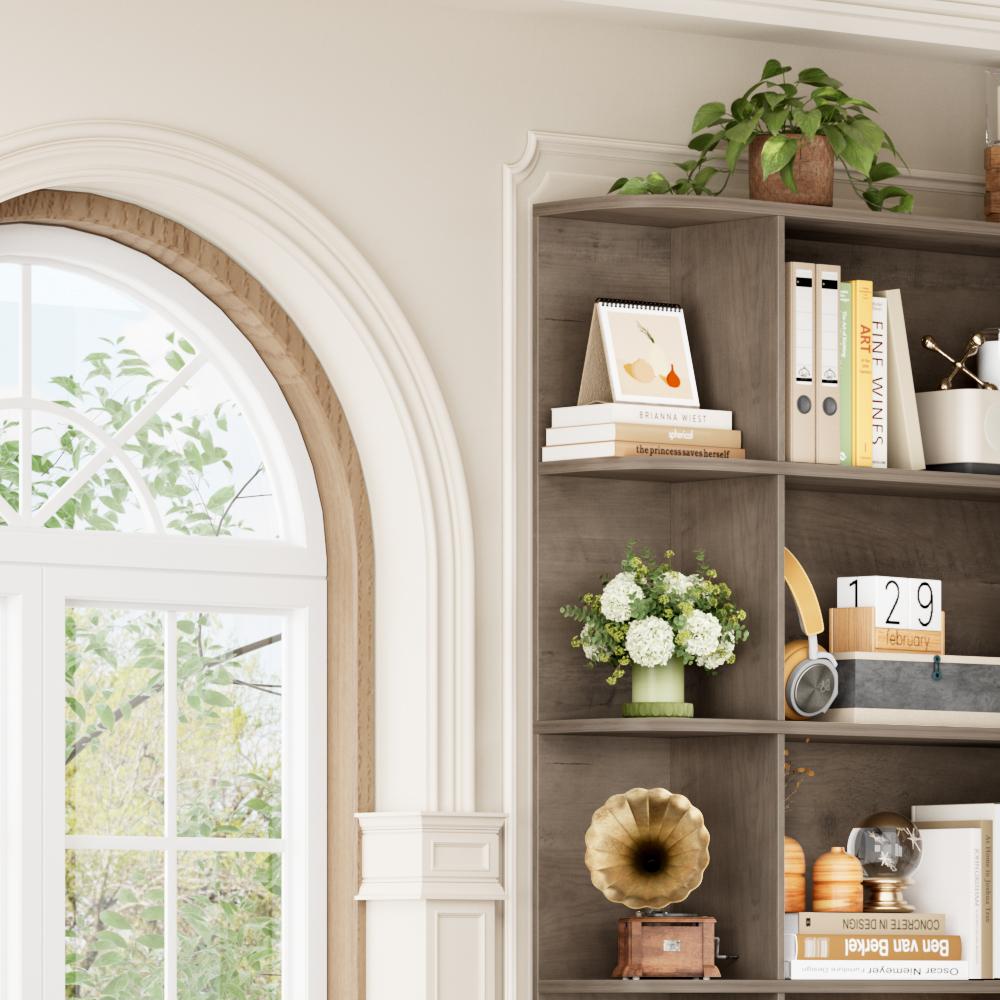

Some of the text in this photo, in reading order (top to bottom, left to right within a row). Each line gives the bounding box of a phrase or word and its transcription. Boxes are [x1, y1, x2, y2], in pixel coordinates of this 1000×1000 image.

[860, 324, 871, 354] ART
[872, 320, 884, 366] FINE
[681, 413, 708, 424] WIEST
[872, 378, 884, 446] WINES
[636, 444, 731, 460] the princess saves herself
[849, 579, 858, 608] 1
[886, 631, 931, 649] february
[842, 918, 940, 930] CONCRETE IN DESIGN
[844, 938, 950, 957] Ben van Berkel
[868, 966, 922, 976] Niemeyer
[925, 967, 960, 976] Oscar
